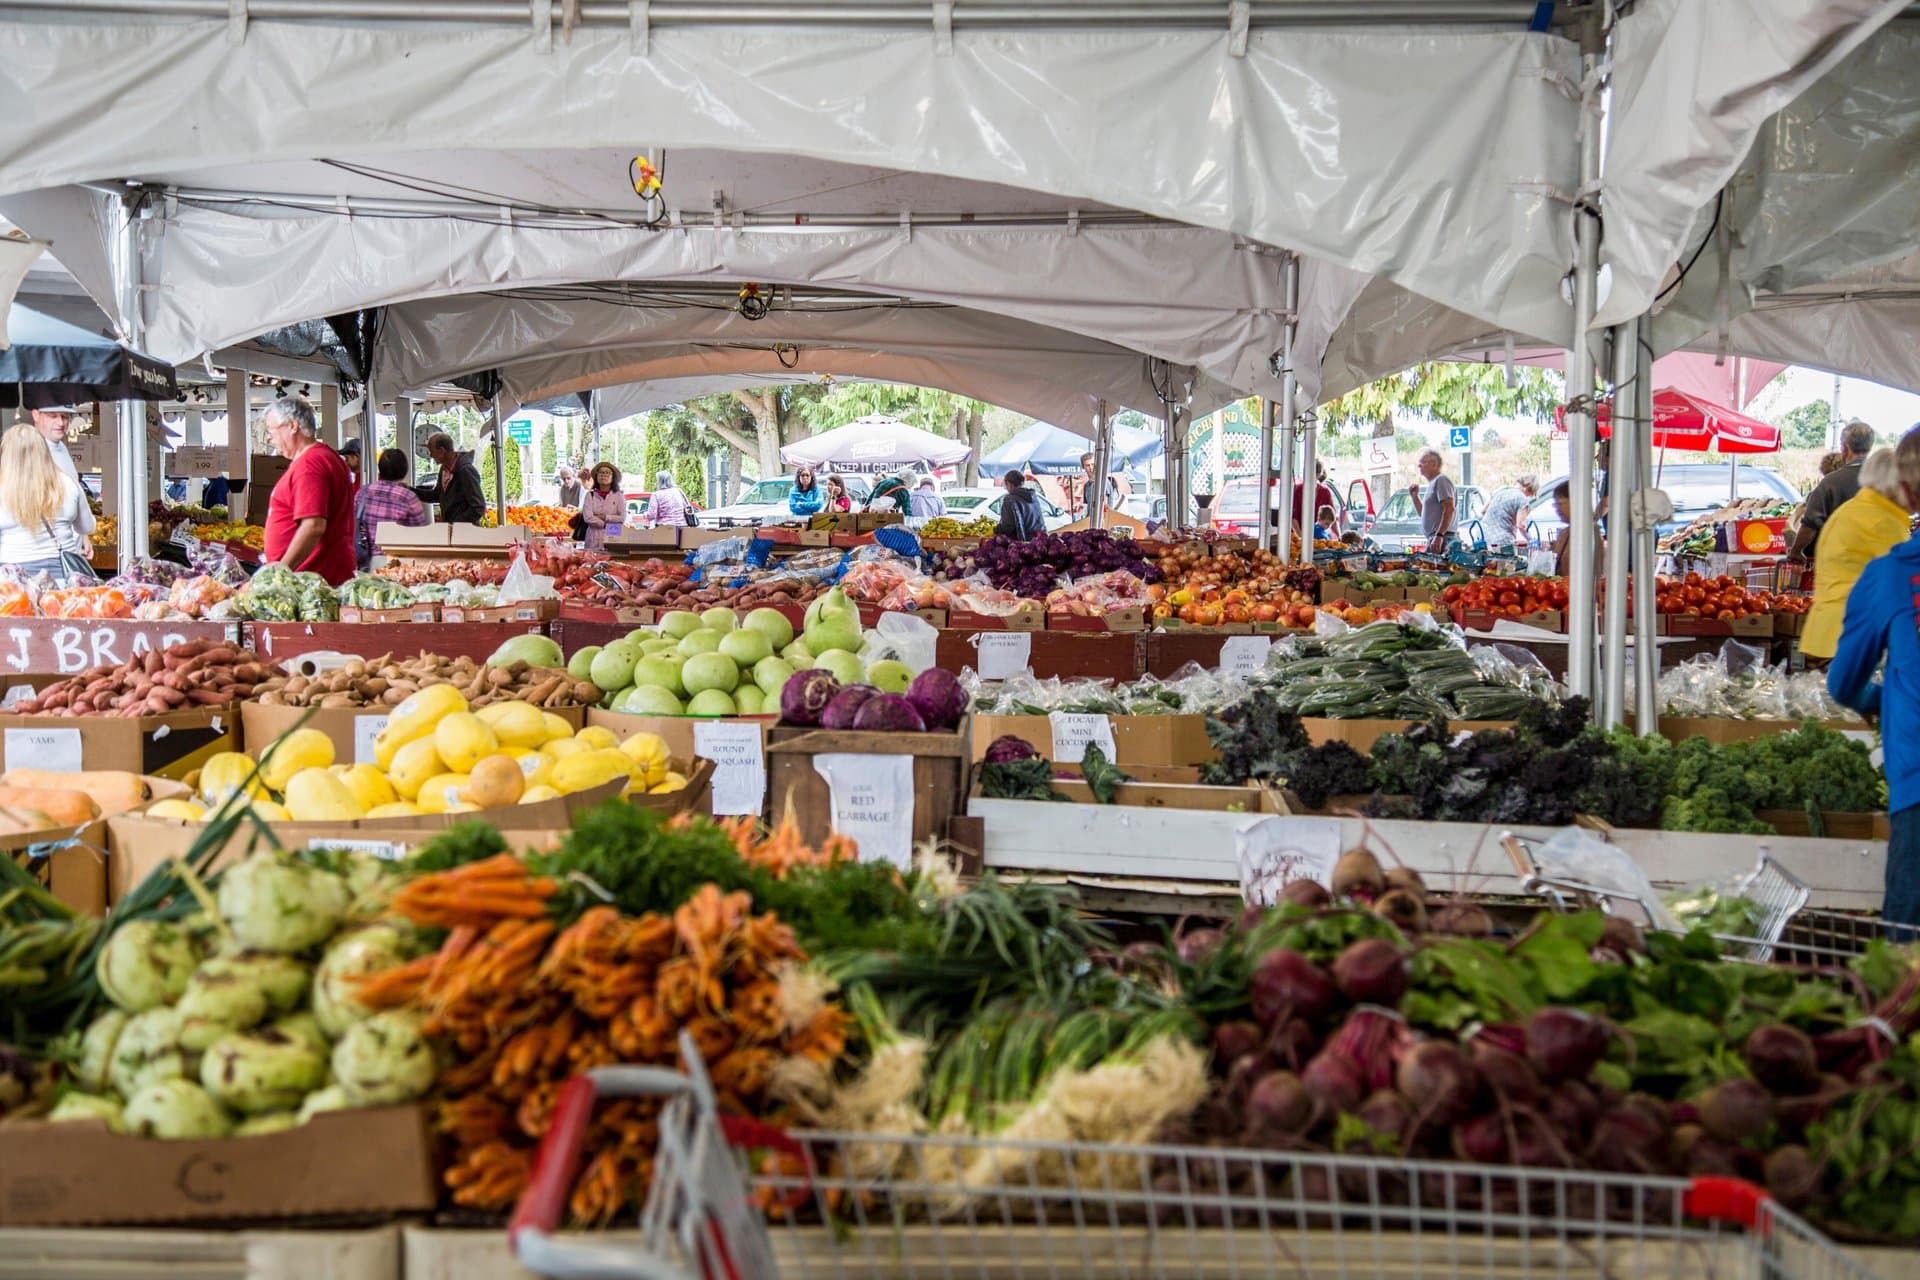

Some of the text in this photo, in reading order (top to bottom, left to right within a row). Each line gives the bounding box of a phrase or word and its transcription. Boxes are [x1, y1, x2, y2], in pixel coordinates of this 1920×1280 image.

[1188, 411, 1238, 449] RICHMND
[1551, 431, 1569, 440] CAU
[833, 462, 859, 473] KEEP
[860, 462, 871, 473] IT
[6, 627, 33, 673] J
[1071, 728, 1092, 736] MINI
[29, 735, 56, 745] YAMS
[712, 744, 745, 753] ROUND
[850, 796, 876, 806] RED
[837, 811, 891, 823] CABBAGE
